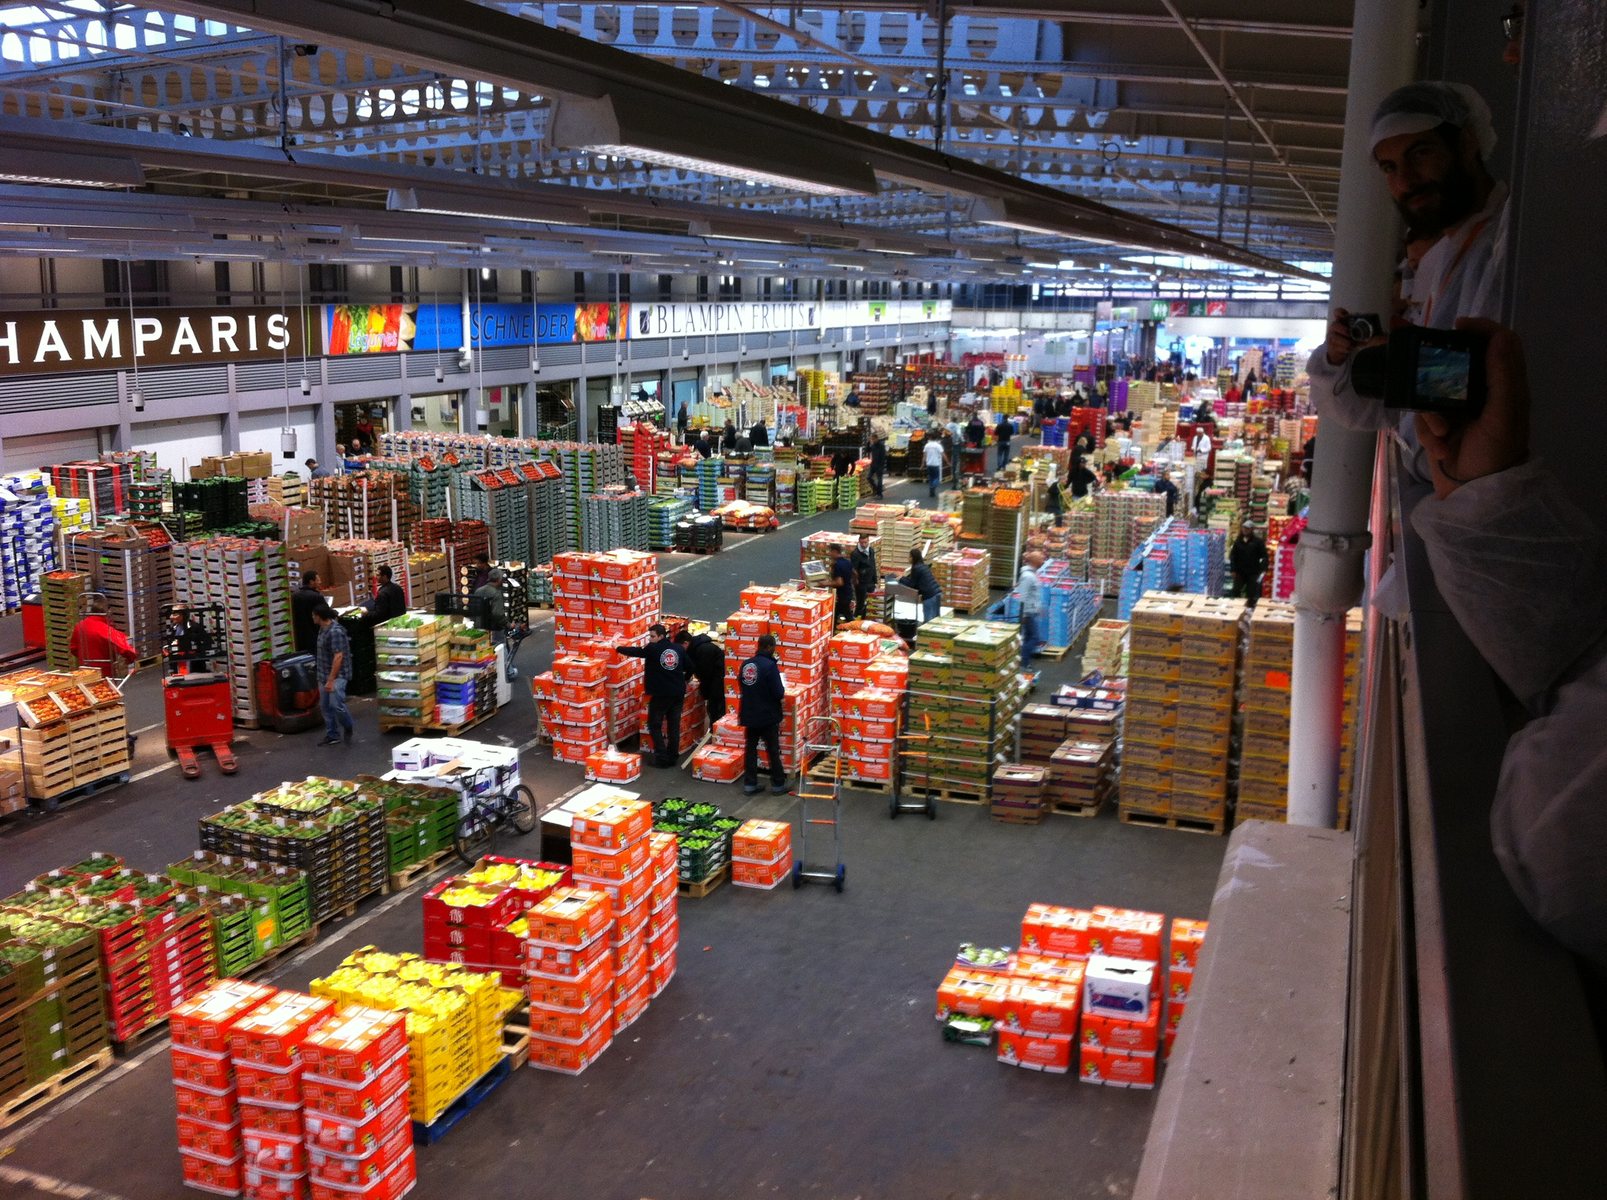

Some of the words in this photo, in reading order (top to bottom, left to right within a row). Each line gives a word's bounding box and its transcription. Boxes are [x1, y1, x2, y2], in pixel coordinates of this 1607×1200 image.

[471, 310, 568, 341] SCHNEIDER
[657, 303, 744, 334] BLAMPIN
[751, 303, 805, 330] FRUITS
